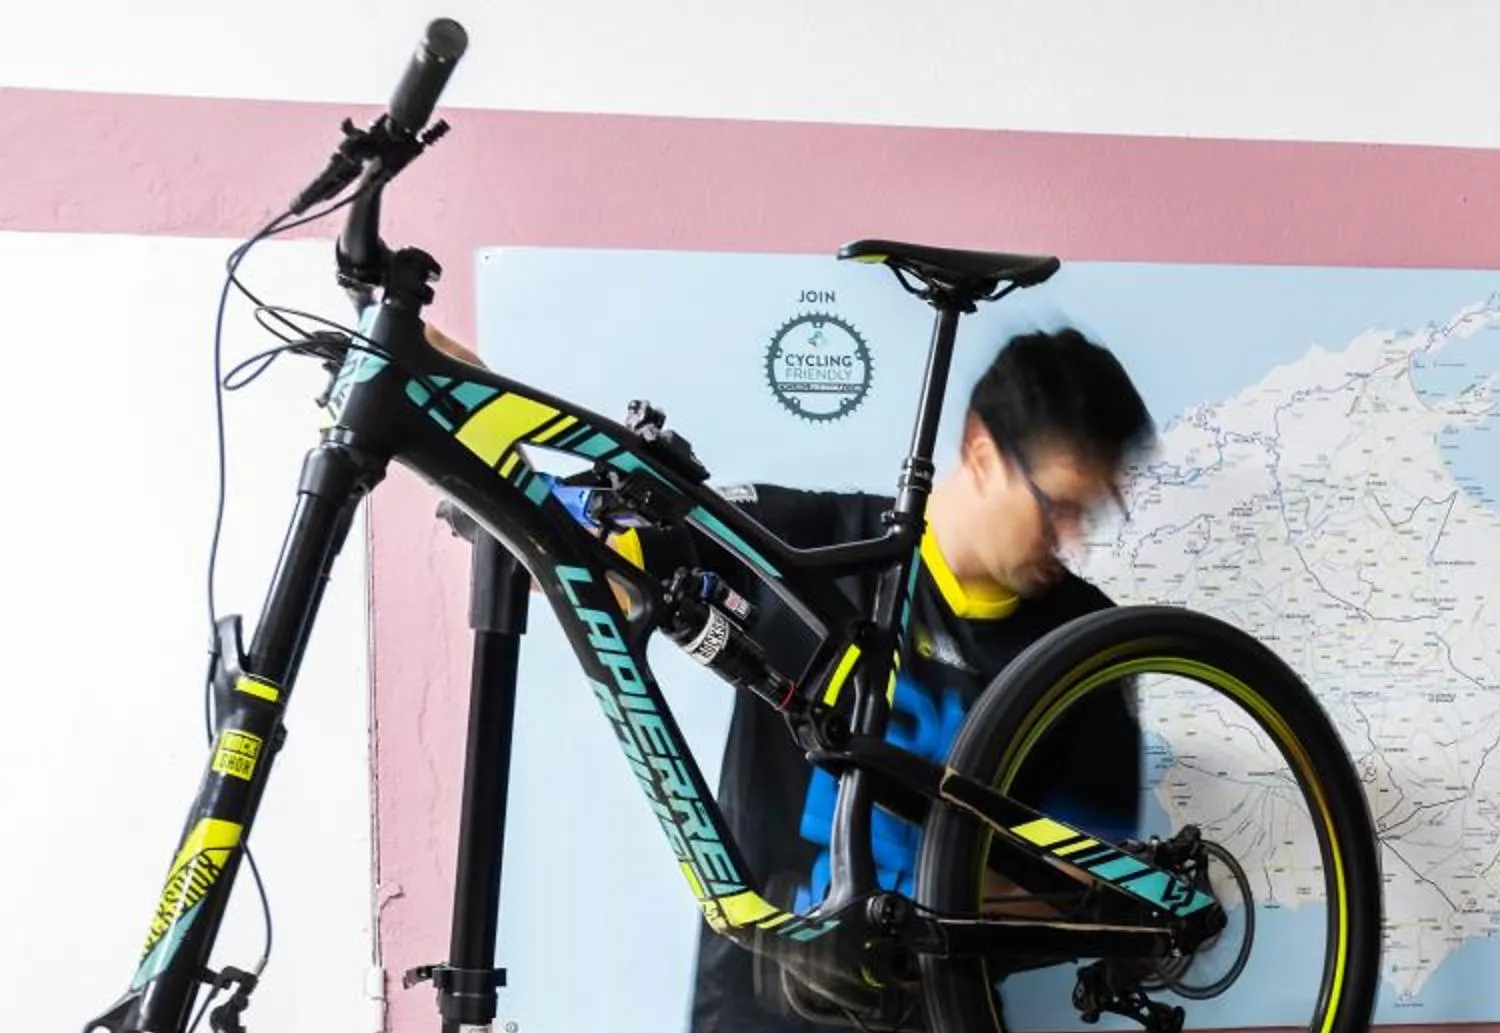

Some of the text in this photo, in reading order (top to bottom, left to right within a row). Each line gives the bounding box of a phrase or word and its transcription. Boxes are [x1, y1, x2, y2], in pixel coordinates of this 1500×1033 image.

[799, 290, 836, 303] JOIN
[785, 354, 853, 367] CYCLING
[785, 368, 853, 381] FRIENDLY
[556, 565, 745, 893] LAPIERRE
